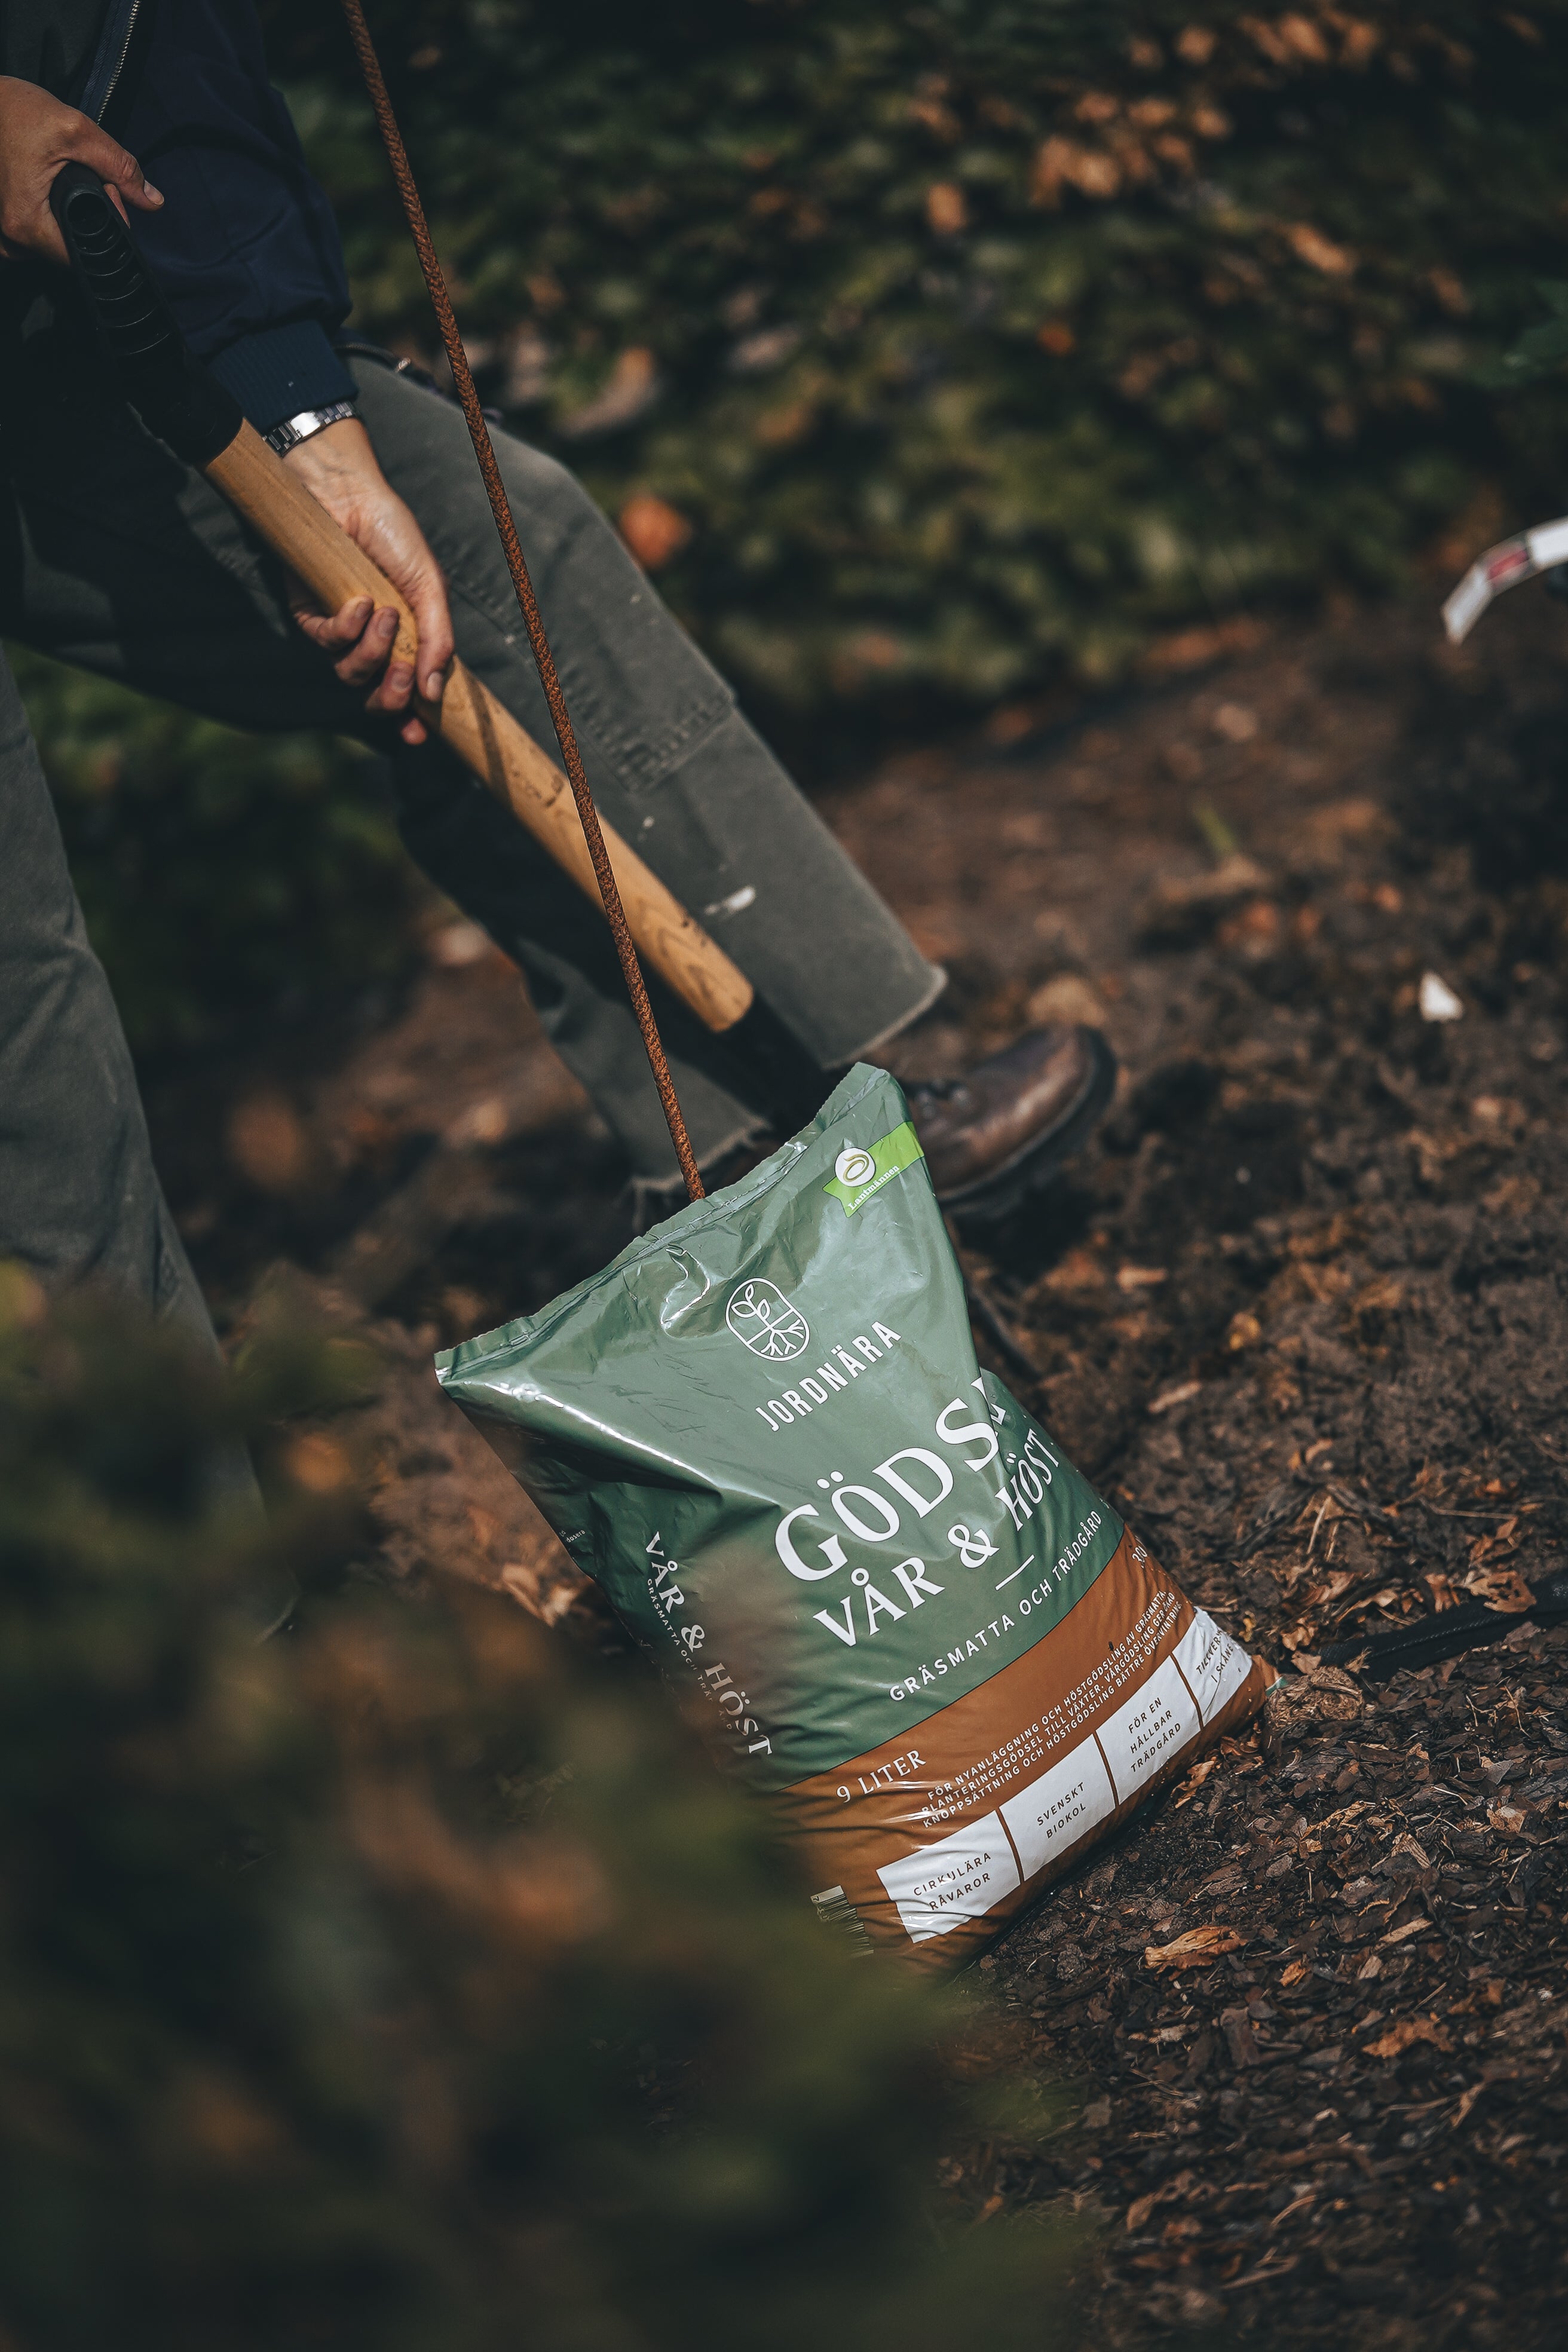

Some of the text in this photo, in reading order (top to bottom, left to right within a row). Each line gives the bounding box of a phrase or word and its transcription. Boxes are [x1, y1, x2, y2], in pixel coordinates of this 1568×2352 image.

[848, 1165, 900, 1211] Lantmännen
[755, 1321, 902, 1432] JORDNÄRA
[813, 1428, 1059, 1647] VÅR & HÖST
[647, 1579, 681, 1646] GRÄSMATTA
[889, 1510, 1102, 1701] GRÄSMATTA OCH TRÄDGÅRD
[645, 1531, 773, 1754] VÅR & HÖST
[921, 1735, 1043, 1813] PLANTERINGSGÖDSEL
[1044, 1716, 1067, 1737] TILL
[1067, 1684, 1104, 1717] VÄXTER.
[1104, 1626, 1154, 1683] VÅRGÖDSLING
[1153, 1609, 1165, 1627] GER
[927, 1783, 953, 1800] FÖR
[954, 1723, 1039, 1786] NYANLÄGGNING
[1041, 1704, 1062, 1725] OCH
[1063, 1643, 1126, 1707] HÖSTGÖDSLING
[1125, 1631, 1135, 1646] AV
[1128, 1697, 1162, 1734] FÖR EN
[1130, 1710, 1172, 1754] HÅLLBAR
[923, 1765, 1020, 1829] KNOPPSÄTTNING
[1022, 1747, 1045, 1768] OCH
[1046, 1685, 1115, 1750] HÖSTGÖDSLING
[1115, 1653, 1145, 1688] BÄTTRE
[1130, 1723, 1181, 1772] TRÄDGÅRD
[837, 1750, 927, 1803] 9 LITER
[1036, 1782, 1085, 1826] SVENSKT
[1046, 1803, 1087, 1839] BIOKOL
[913, 1852, 992, 1896] CIRKULÄRA
[929, 1873, 991, 1911] RÅVAROR
